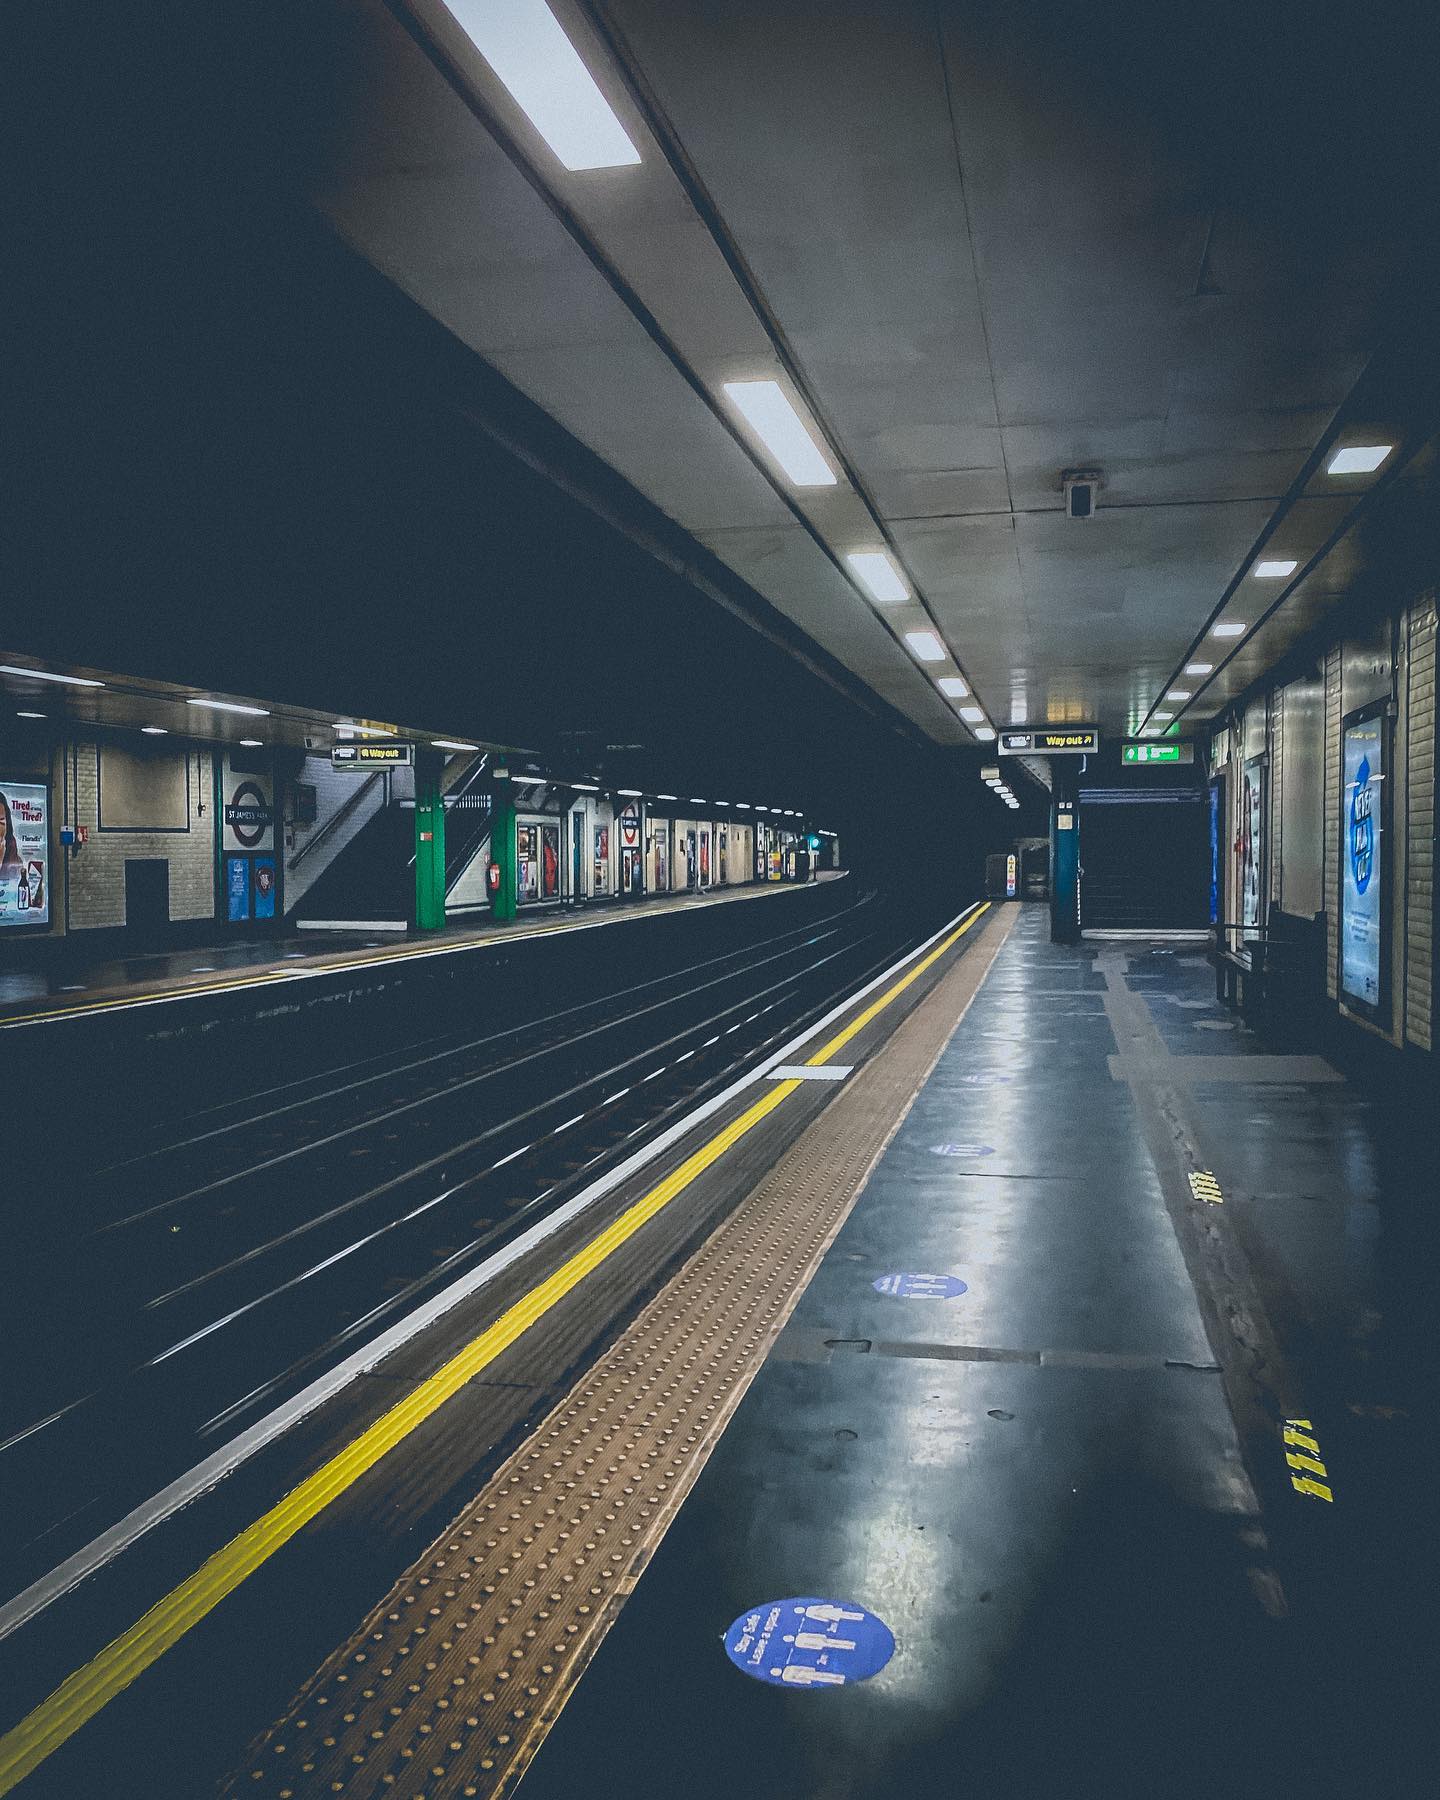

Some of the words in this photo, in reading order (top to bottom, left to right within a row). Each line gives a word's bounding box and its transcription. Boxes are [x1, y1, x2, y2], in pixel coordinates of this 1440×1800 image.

[1045, 736, 1066, 746] Way
[1066, 736, 1083, 745] out
[369, 748, 385, 758] Way
[385, 749, 399, 757] out
[11, 800, 30, 811] Tired
[22, 812, 42, 822] Tired?
[743, 1614, 760, 1633] Safe
[747, 1639, 768, 1664] Leave
[764, 1607, 781, 1632] space
[734, 1634, 755, 1652] Stay
